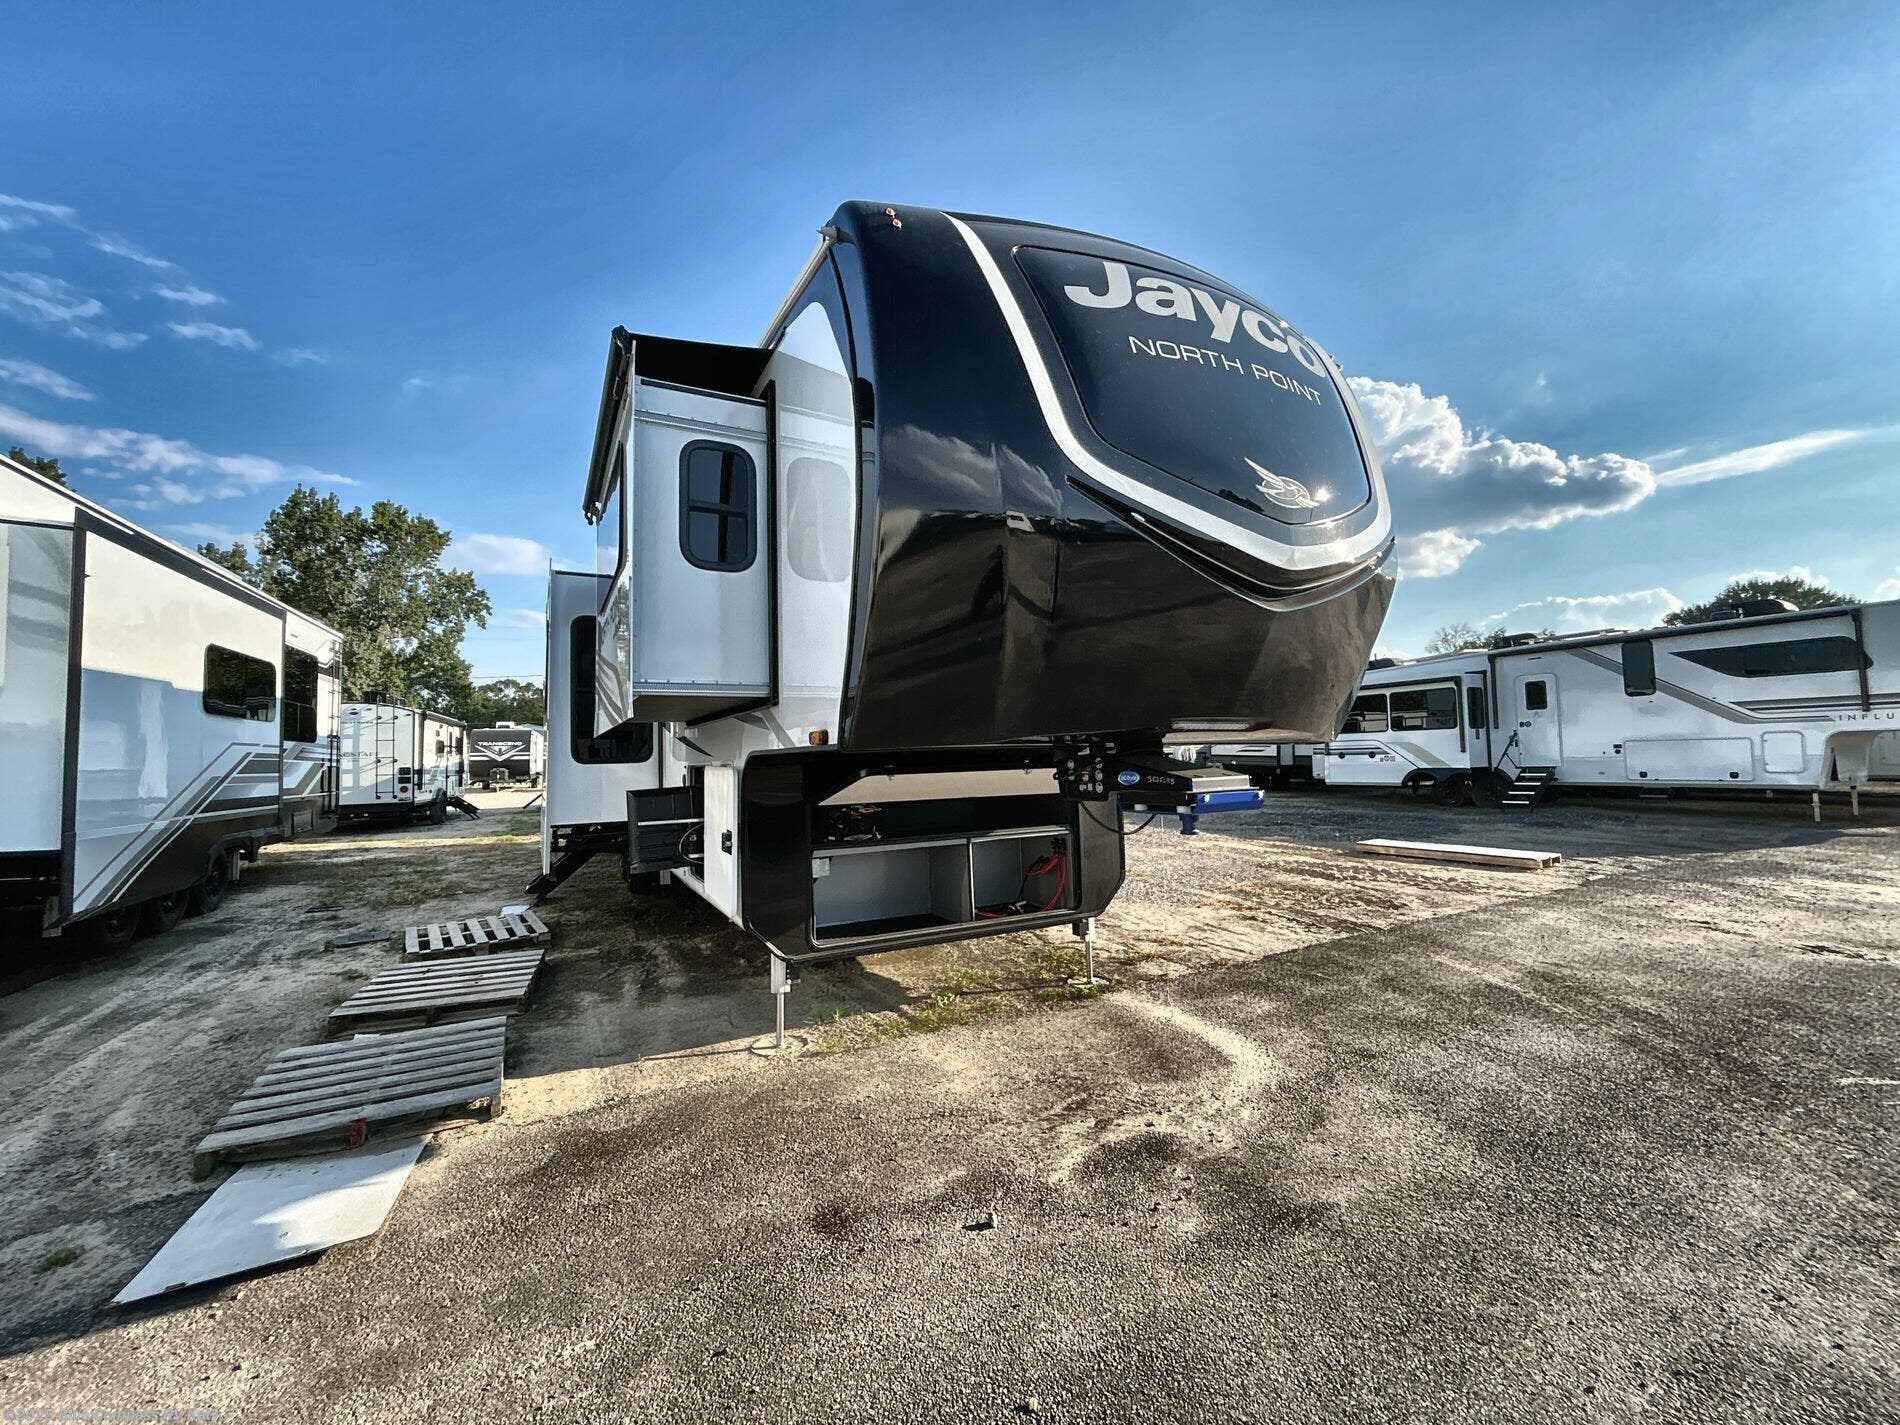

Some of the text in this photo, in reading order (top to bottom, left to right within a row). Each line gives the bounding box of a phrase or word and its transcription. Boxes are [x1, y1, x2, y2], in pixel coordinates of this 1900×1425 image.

[1063, 261, 1326, 378] Jayco
[1128, 336, 1321, 406] NORTH POINT
